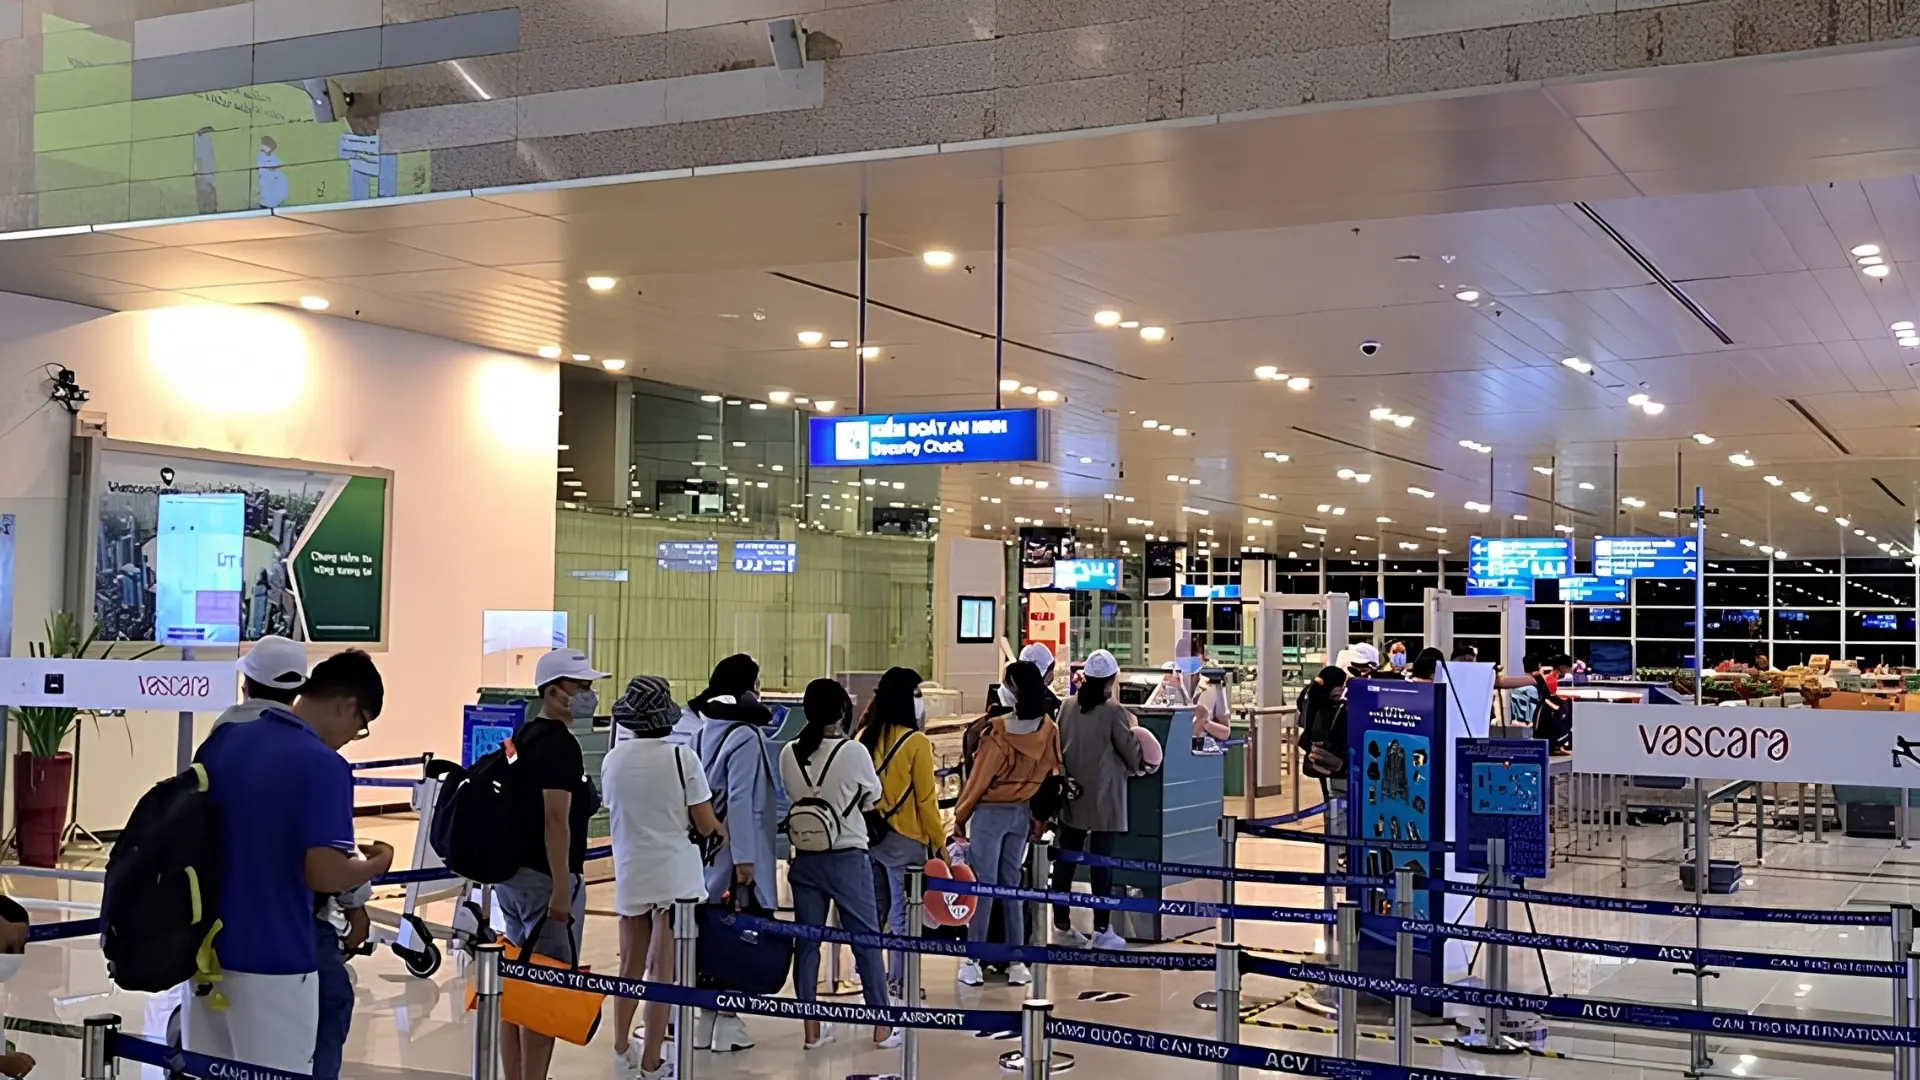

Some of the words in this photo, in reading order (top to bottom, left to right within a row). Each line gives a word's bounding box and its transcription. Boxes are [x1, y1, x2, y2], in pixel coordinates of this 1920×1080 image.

[138, 674, 210, 697] vascara
[1638, 723, 1789, 761] vascara
[1658, 945, 1693, 961] ACV
[1582, 1003, 1621, 1019] ACV
[1265, 1052, 1310, 1072] ACV
